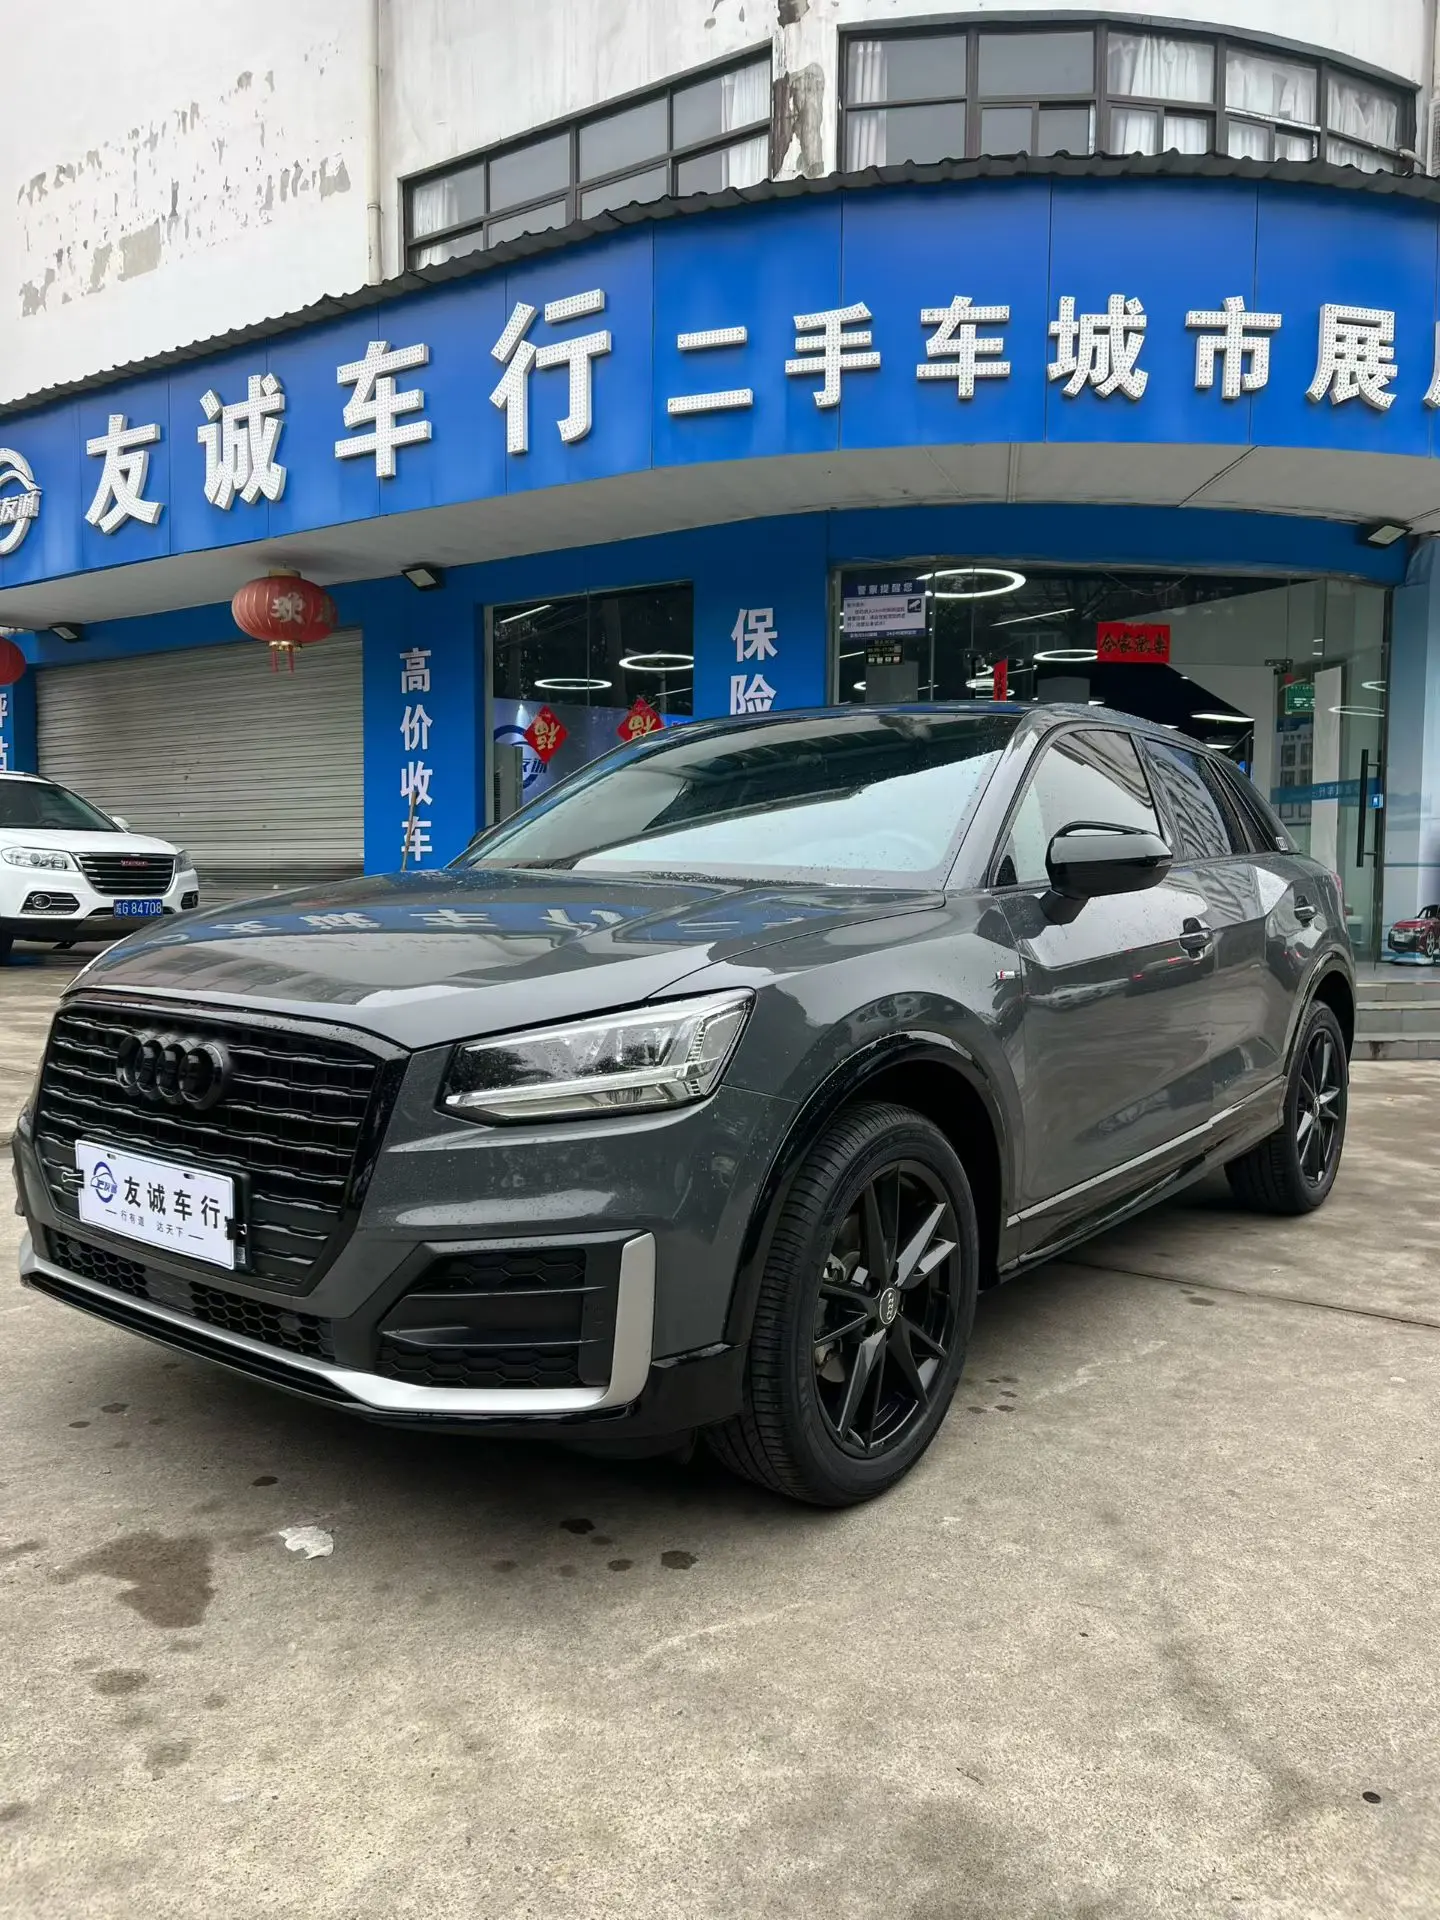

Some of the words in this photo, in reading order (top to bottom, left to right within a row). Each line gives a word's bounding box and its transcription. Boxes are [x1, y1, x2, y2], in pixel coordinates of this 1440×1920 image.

[84, 288, 1440, 534] 友诚车行二手车城市展
[730, 607, 778, 715] 保险
[400, 647, 433, 861] 高价收车
[124, 1176, 220, 1229] 友诚车行
